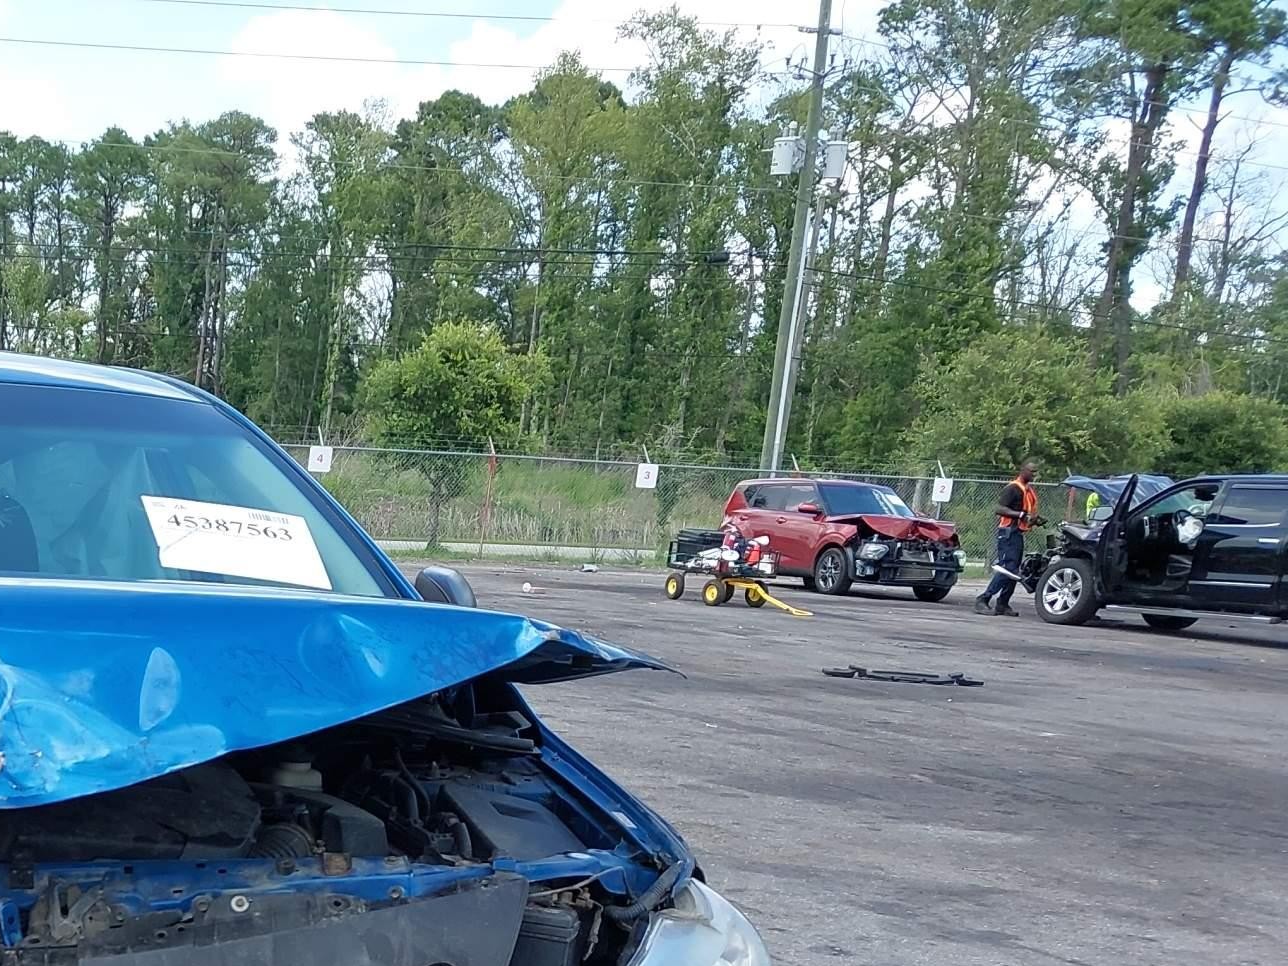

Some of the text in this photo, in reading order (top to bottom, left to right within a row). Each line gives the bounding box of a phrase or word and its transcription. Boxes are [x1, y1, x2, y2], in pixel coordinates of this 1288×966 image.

[643, 470, 651, 480] 3
[938, 484, 947, 494] 2
[167, 513, 293, 542] 45387563
